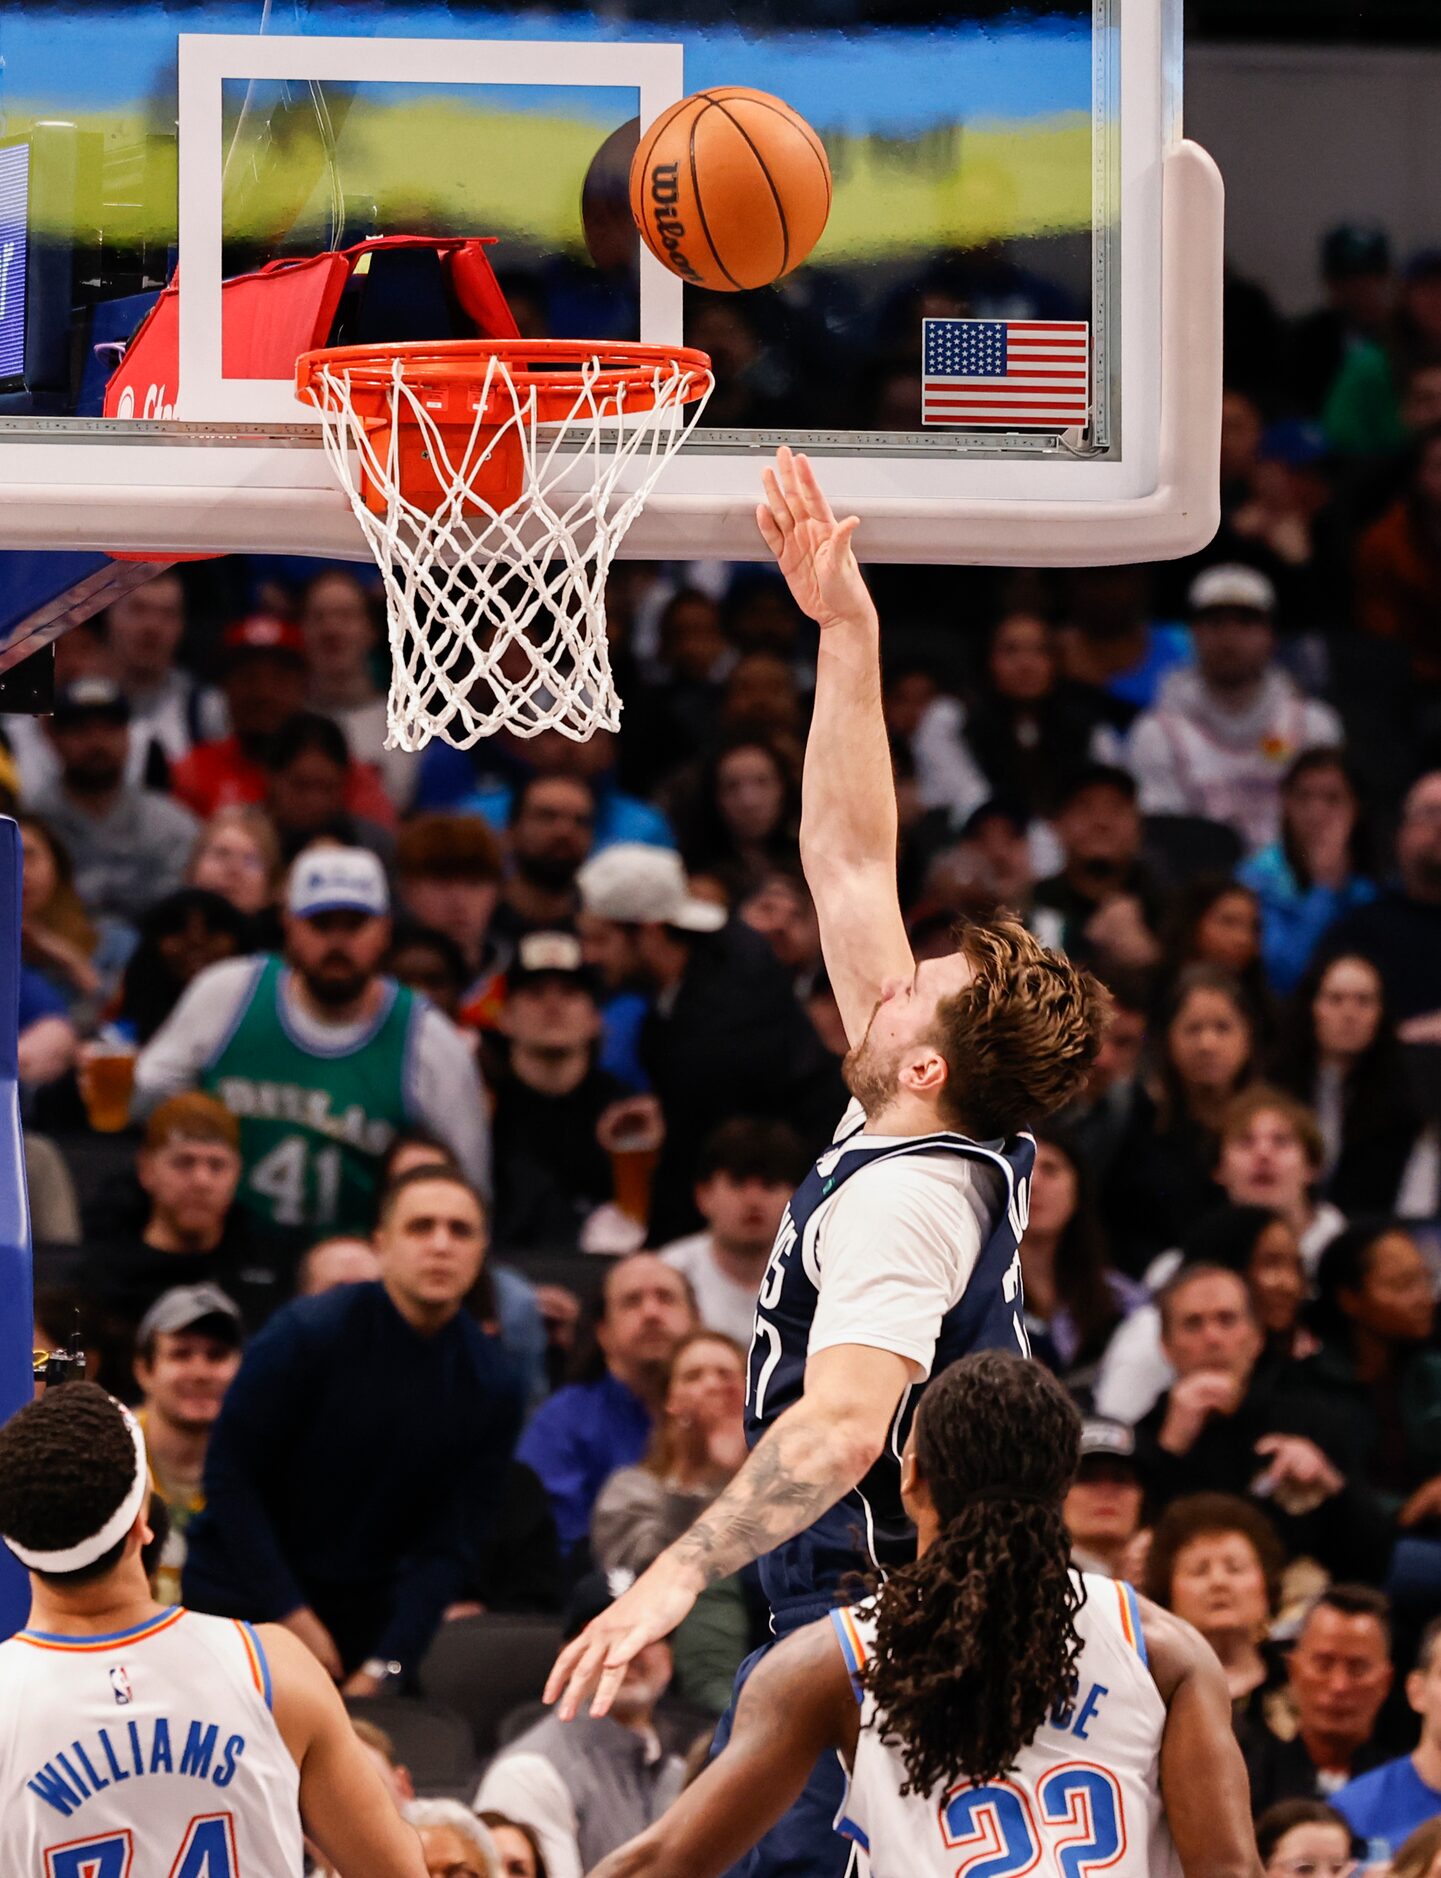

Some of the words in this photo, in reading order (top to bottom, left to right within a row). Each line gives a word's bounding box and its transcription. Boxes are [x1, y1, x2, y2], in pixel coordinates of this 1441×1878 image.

[651, 160, 704, 282] Wilson
[251, 1134, 341, 1226] 41
[27, 1718, 245, 1817] WILLIAMS
[938, 1761, 1127, 1878] 22
